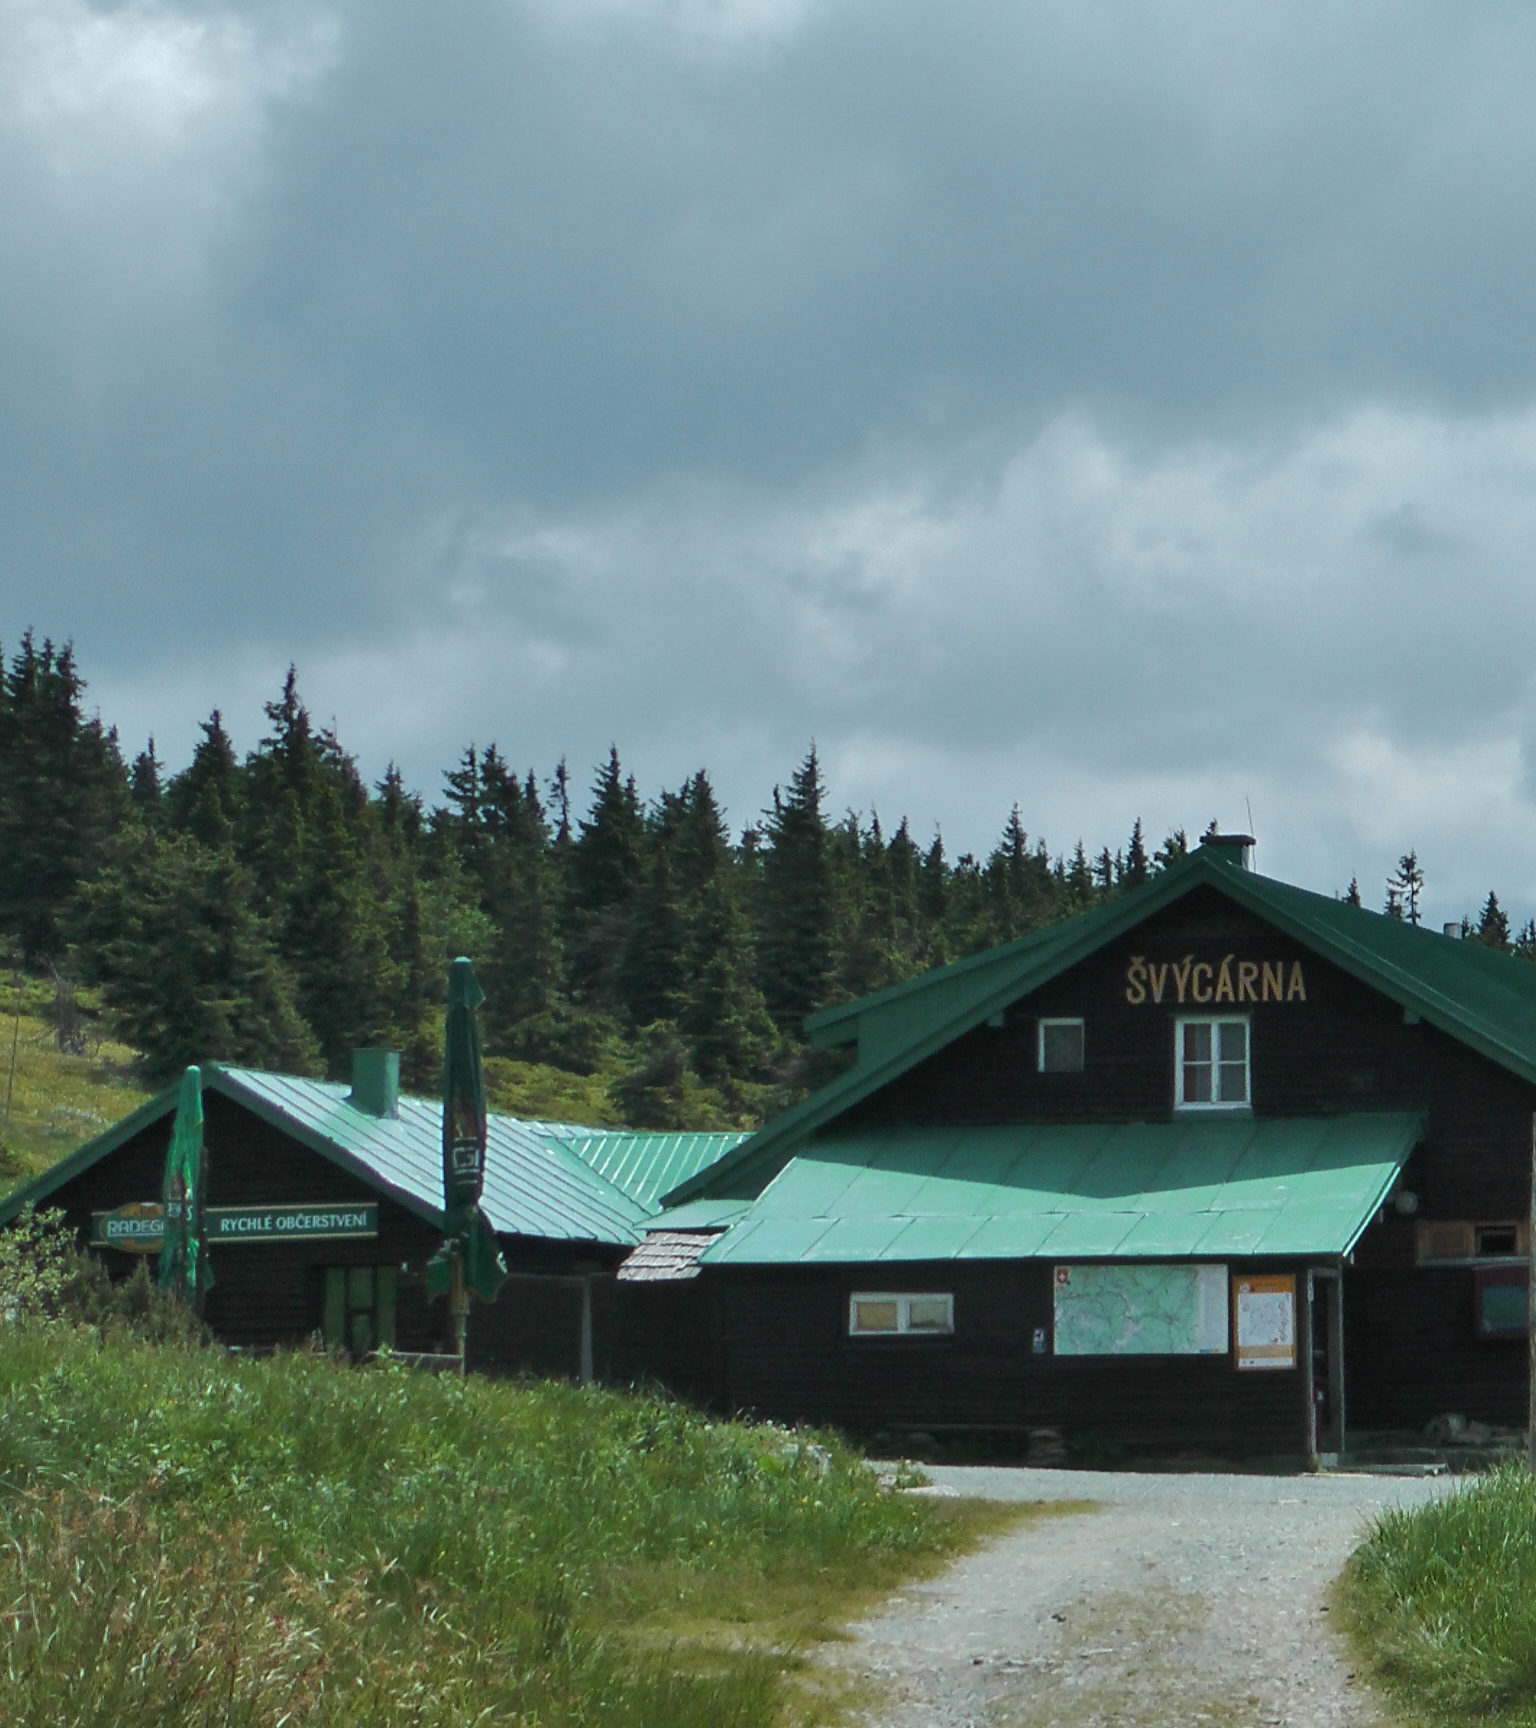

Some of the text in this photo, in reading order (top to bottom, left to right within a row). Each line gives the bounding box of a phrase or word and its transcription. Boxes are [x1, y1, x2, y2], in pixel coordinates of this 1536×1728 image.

[1126, 954, 1307, 1004] ŠVÝCÁRNA
[107, 1220, 164, 1236] RADEG
[220, 1211, 367, 1231] RYCHLÉ OBČERSTVENÍ
